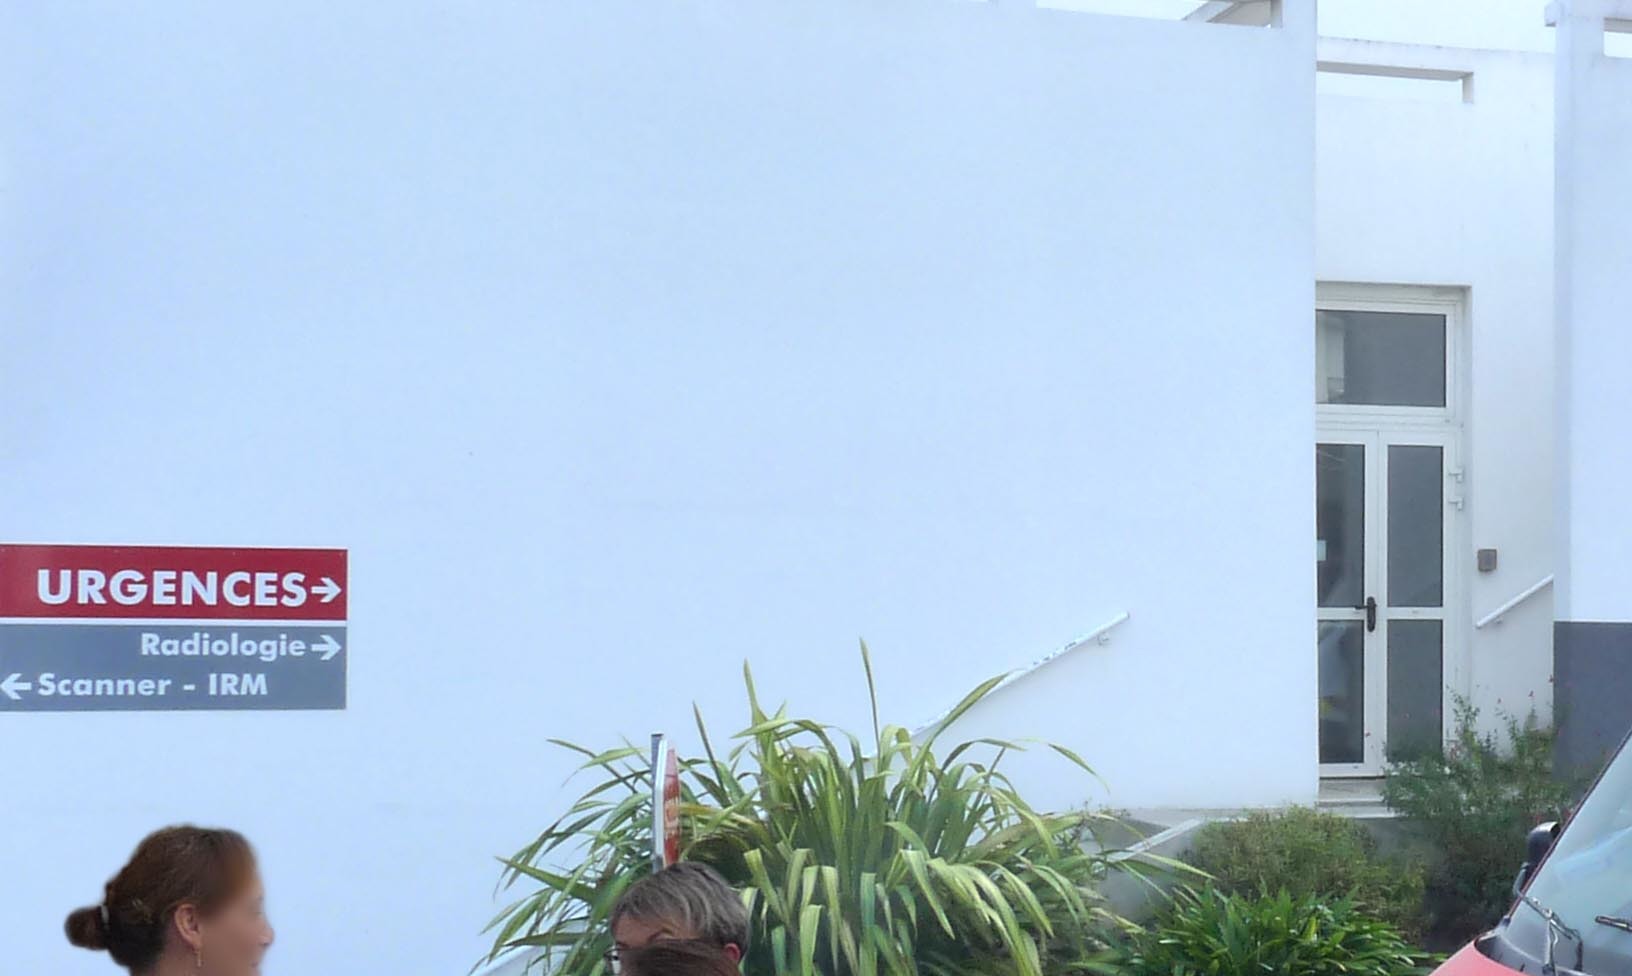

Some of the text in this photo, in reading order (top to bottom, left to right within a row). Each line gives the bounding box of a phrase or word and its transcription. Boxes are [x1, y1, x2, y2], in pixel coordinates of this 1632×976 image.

[37, 568, 308, 608] URGENCES
[140, 631, 307, 662] Radiologie
[37, 672, 173, 697] Scanner
[207, 672, 269, 697] IRM
